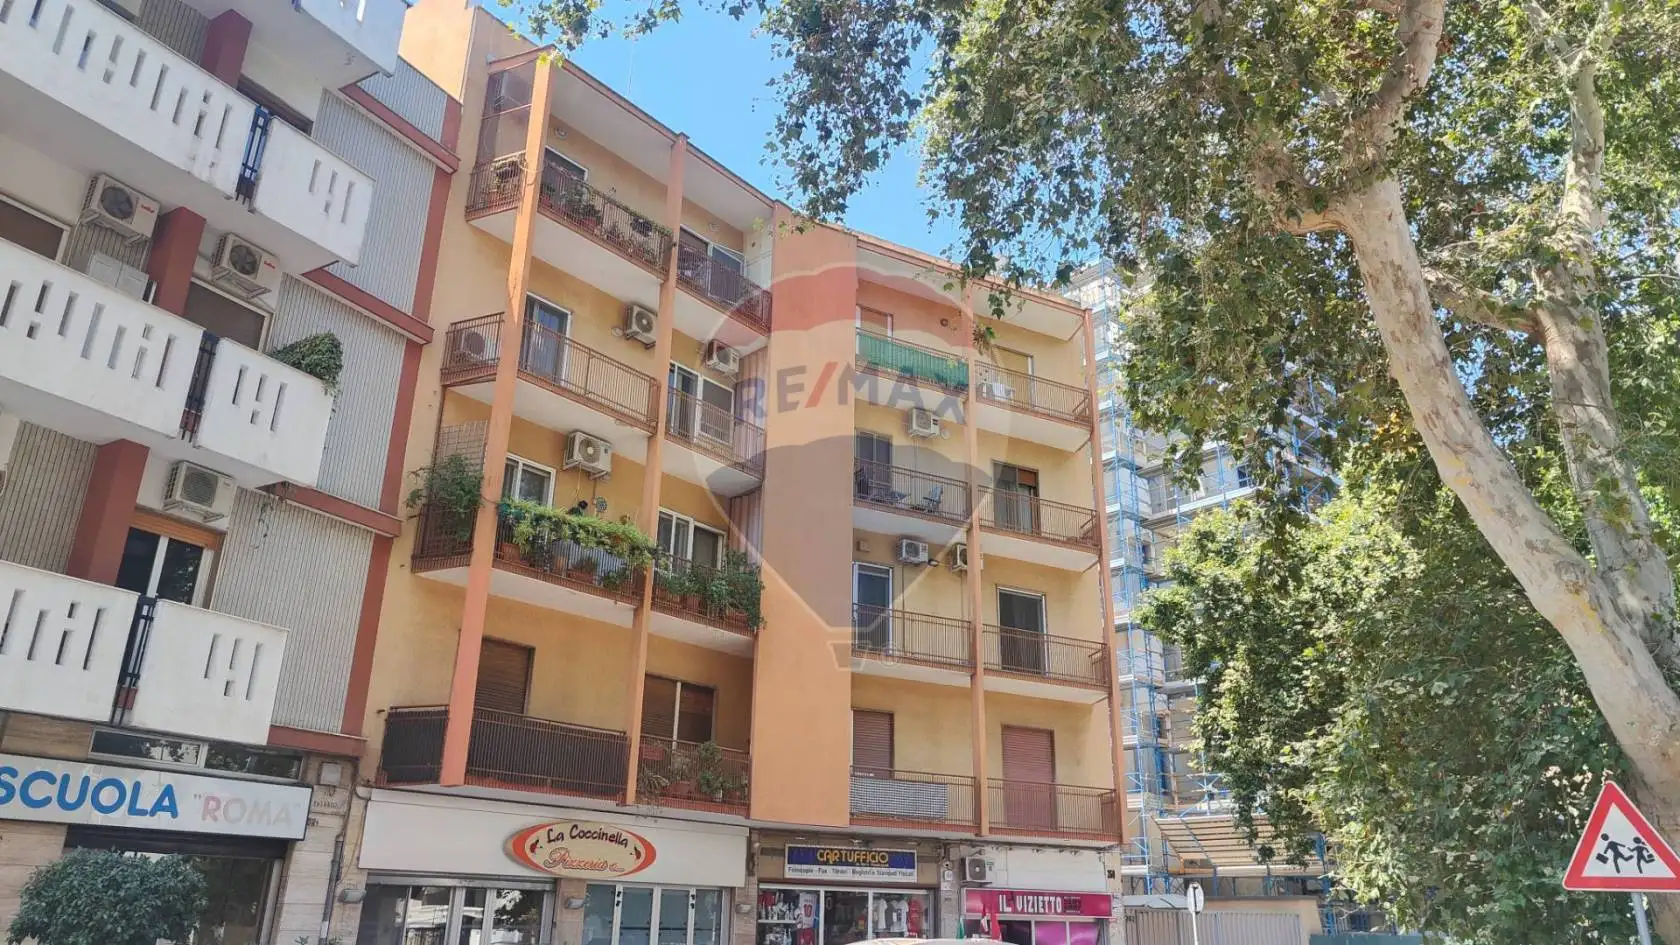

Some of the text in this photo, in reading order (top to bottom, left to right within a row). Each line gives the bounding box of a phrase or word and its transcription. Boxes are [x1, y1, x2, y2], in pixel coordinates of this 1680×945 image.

[0, 766, 179, 819] SCUOLA
[547, 824, 629, 848] La Coccinella
[816, 849, 889, 864] CARTUFFICIO
[999, 894, 1012, 912] IL
[1016, 894, 1062, 914] VIZIETTO
